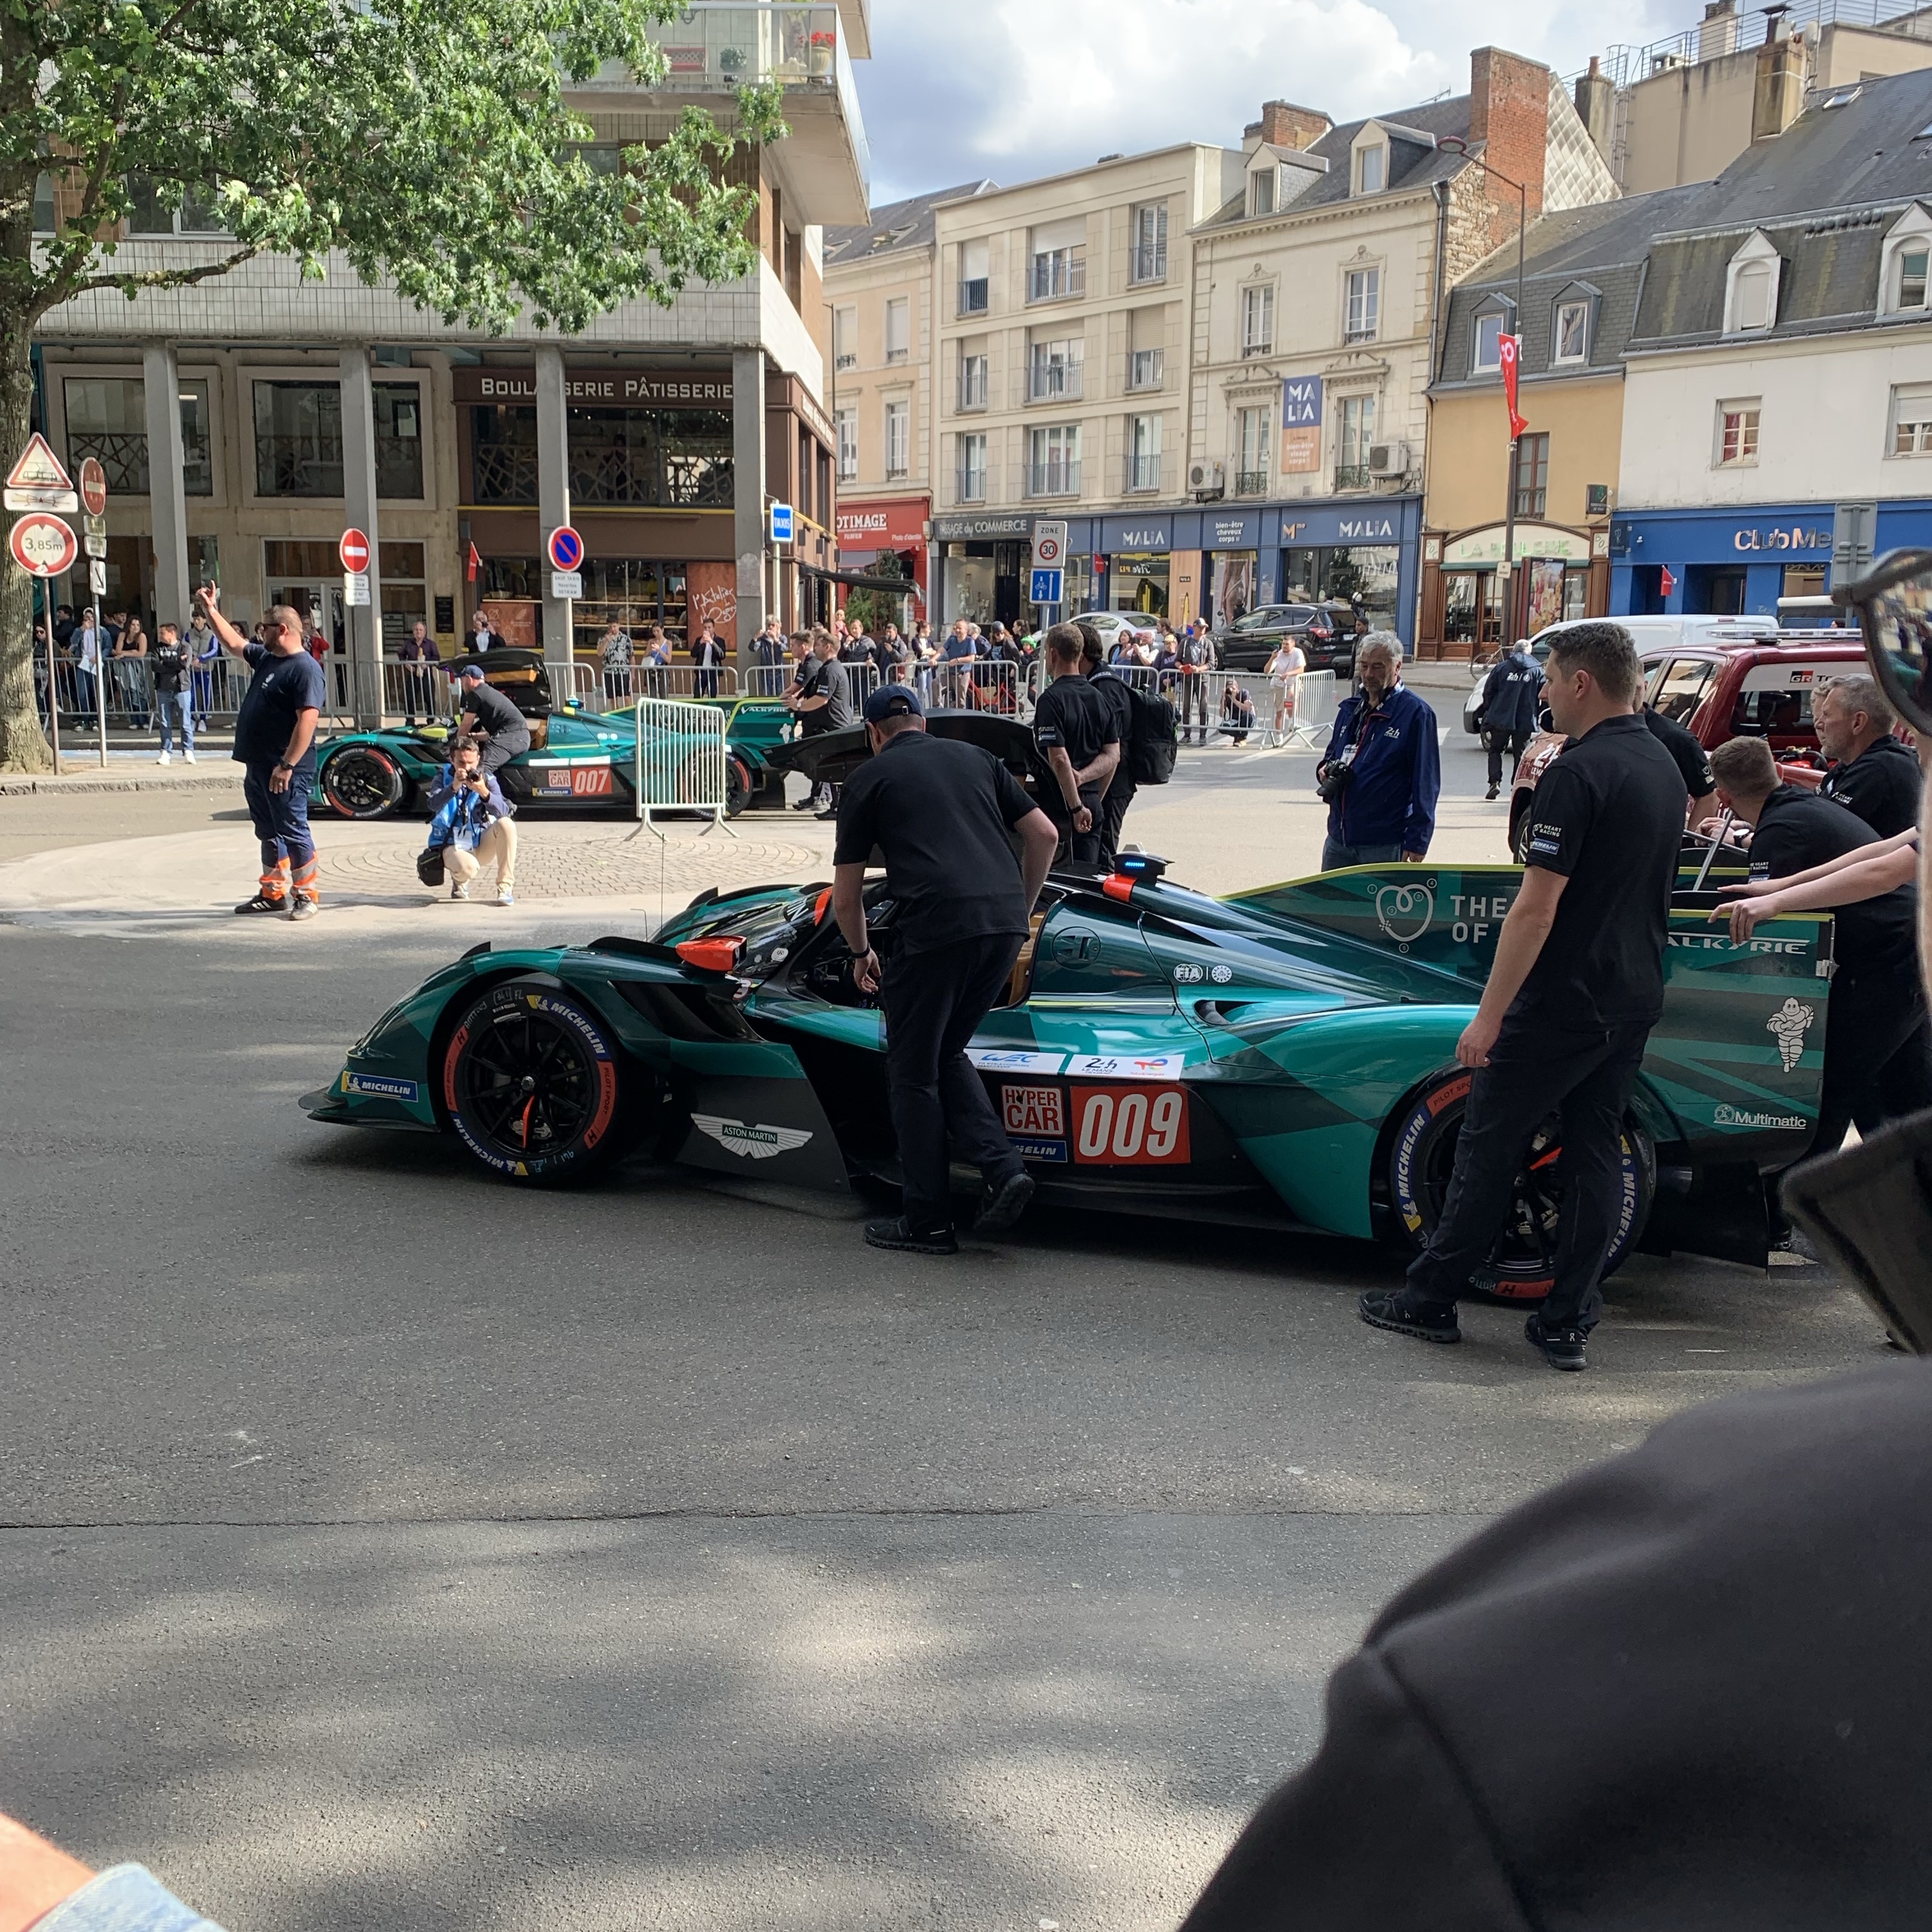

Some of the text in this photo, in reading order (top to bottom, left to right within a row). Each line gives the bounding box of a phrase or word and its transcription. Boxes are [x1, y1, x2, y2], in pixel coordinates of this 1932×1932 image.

[625, 377, 733, 399] PÂTISSERIE
[1289, 383, 1315, 402] MA
[774, 517, 790, 529] TAXIS
[939, 523, 963, 535] PASSAGE
[975, 519, 1027, 533] COMMERCE
[1215, 521, 1244, 529] bien-être
[25, 538, 63, 551] 3,85m
[1792, 528, 1832, 549] Me
[1043, 545, 1054, 555] 30
[551, 777, 570, 786] CAR
[574, 769, 609, 794] 007
[1539, 829, 1560, 838] RACING
[1450, 895, 1508, 918] THE
[1452, 922, 1489, 944] OF
[551, 1002, 606, 1054] MICHELIN
[362, 1081, 411, 1095] MICHELIN
[1433, 1088, 1454, 1107] PILOT
[1006, 1089, 1058, 1107] HYPER
[1006, 1105, 1059, 1131] CAR
[1078, 1091, 1183, 1157] 009
[1735, 1111, 1807, 1127] Multimatic
[454, 1118, 505, 1169] MICHELIN
[724, 1126, 776, 1142] ASTON MARTIN
[1399, 1114, 1425, 1199] MICHELIN
